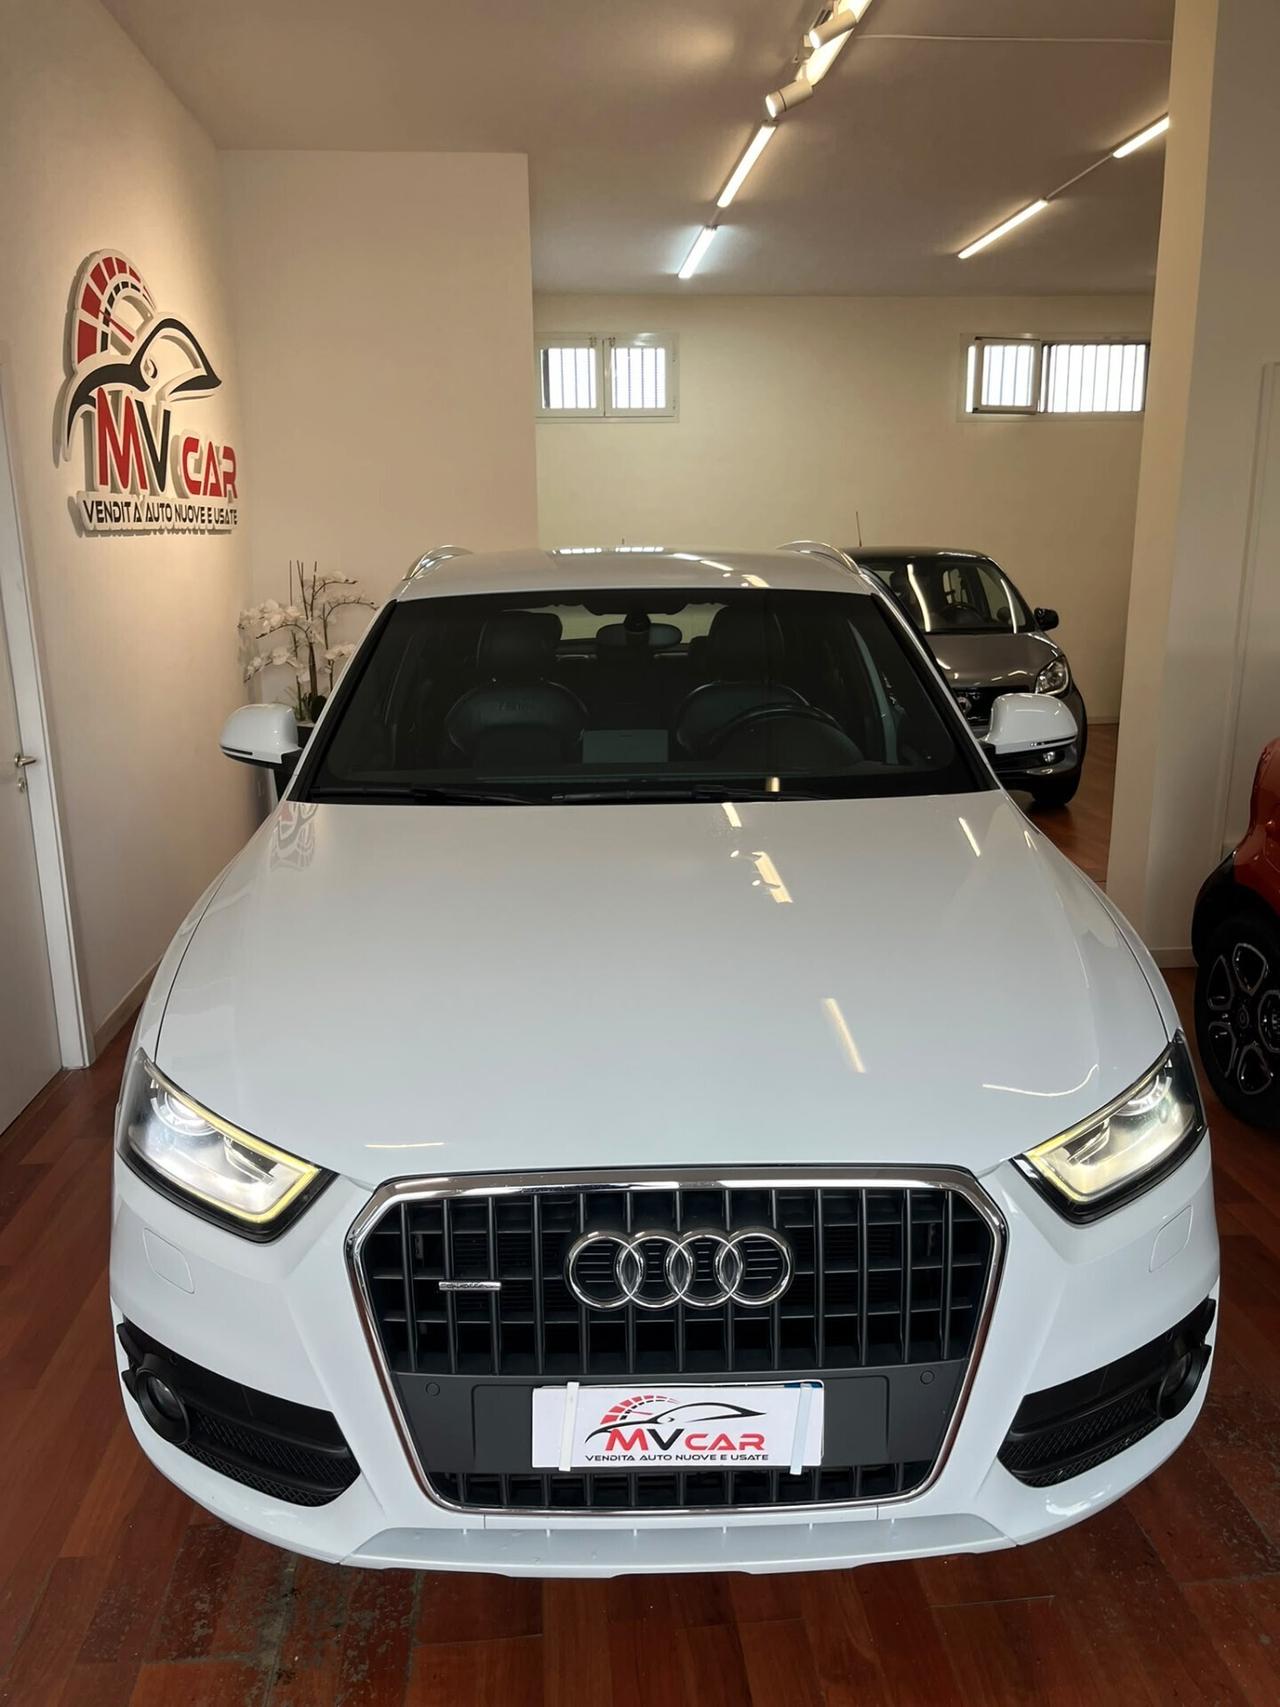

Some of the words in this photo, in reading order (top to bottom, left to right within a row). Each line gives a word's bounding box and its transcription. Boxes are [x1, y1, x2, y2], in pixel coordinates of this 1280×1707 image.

[182, 436, 238, 499] CAR
[83, 500, 142, 524] VENDITA
[145, 502, 173, 523] AUTO
[175, 504, 205, 524] NUOVE
[207, 507, 212, 524] E
[214, 508, 238, 526] USATE
